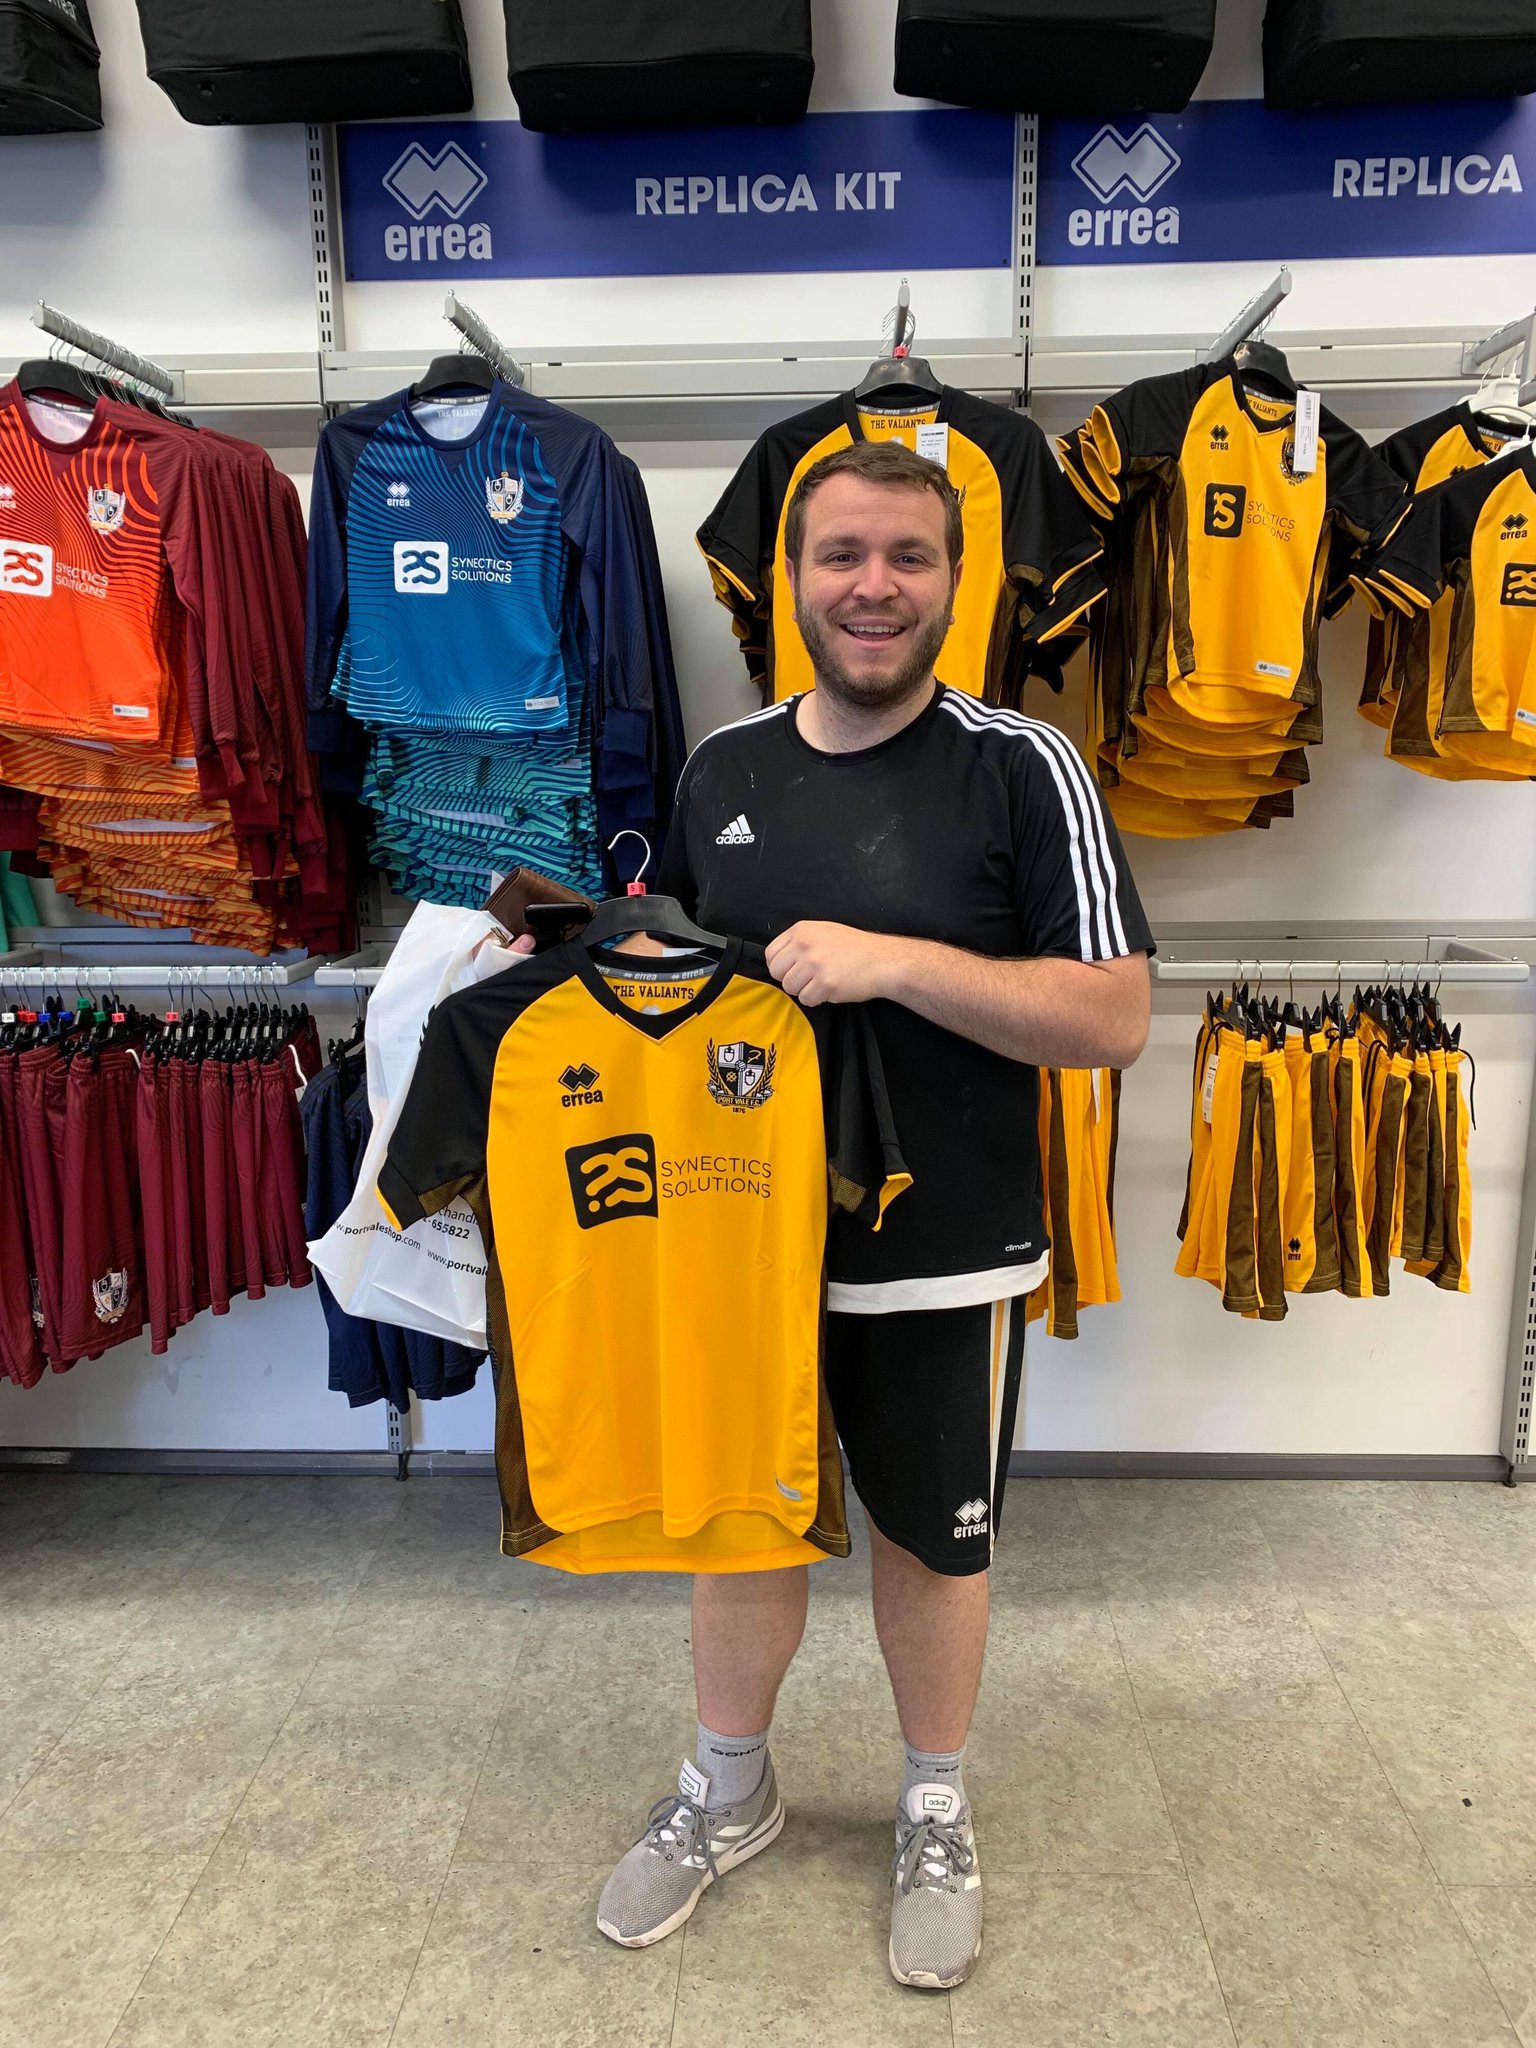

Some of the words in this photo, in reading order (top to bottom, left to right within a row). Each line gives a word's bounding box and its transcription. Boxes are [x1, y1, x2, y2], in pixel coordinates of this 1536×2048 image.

[1332, 154, 1523, 198] REPLICA
[635, 174, 818, 215] REPLICA
[835, 172, 902, 211] KIT
[1253, 401, 1278, 418] VALIANTS
[871, 420, 886, 429] THE
[386, 498, 411, 507] errea
[451, 557, 513, 571] SYNECTICS
[451, 570, 512, 584] SOLUTIONS
[715, 833, 755, 845] adidas
[613, 985, 635, 998] THE
[639, 986, 694, 1000] VALIANTS
[718, 1096, 734, 1105] PORT
[735, 1097, 749, 1106] VALE
[661, 1156, 772, 1179] SYNECTICS
[662, 1177, 771, 1199] SOLUTIONS
[953, 1521, 988, 1539] errea
